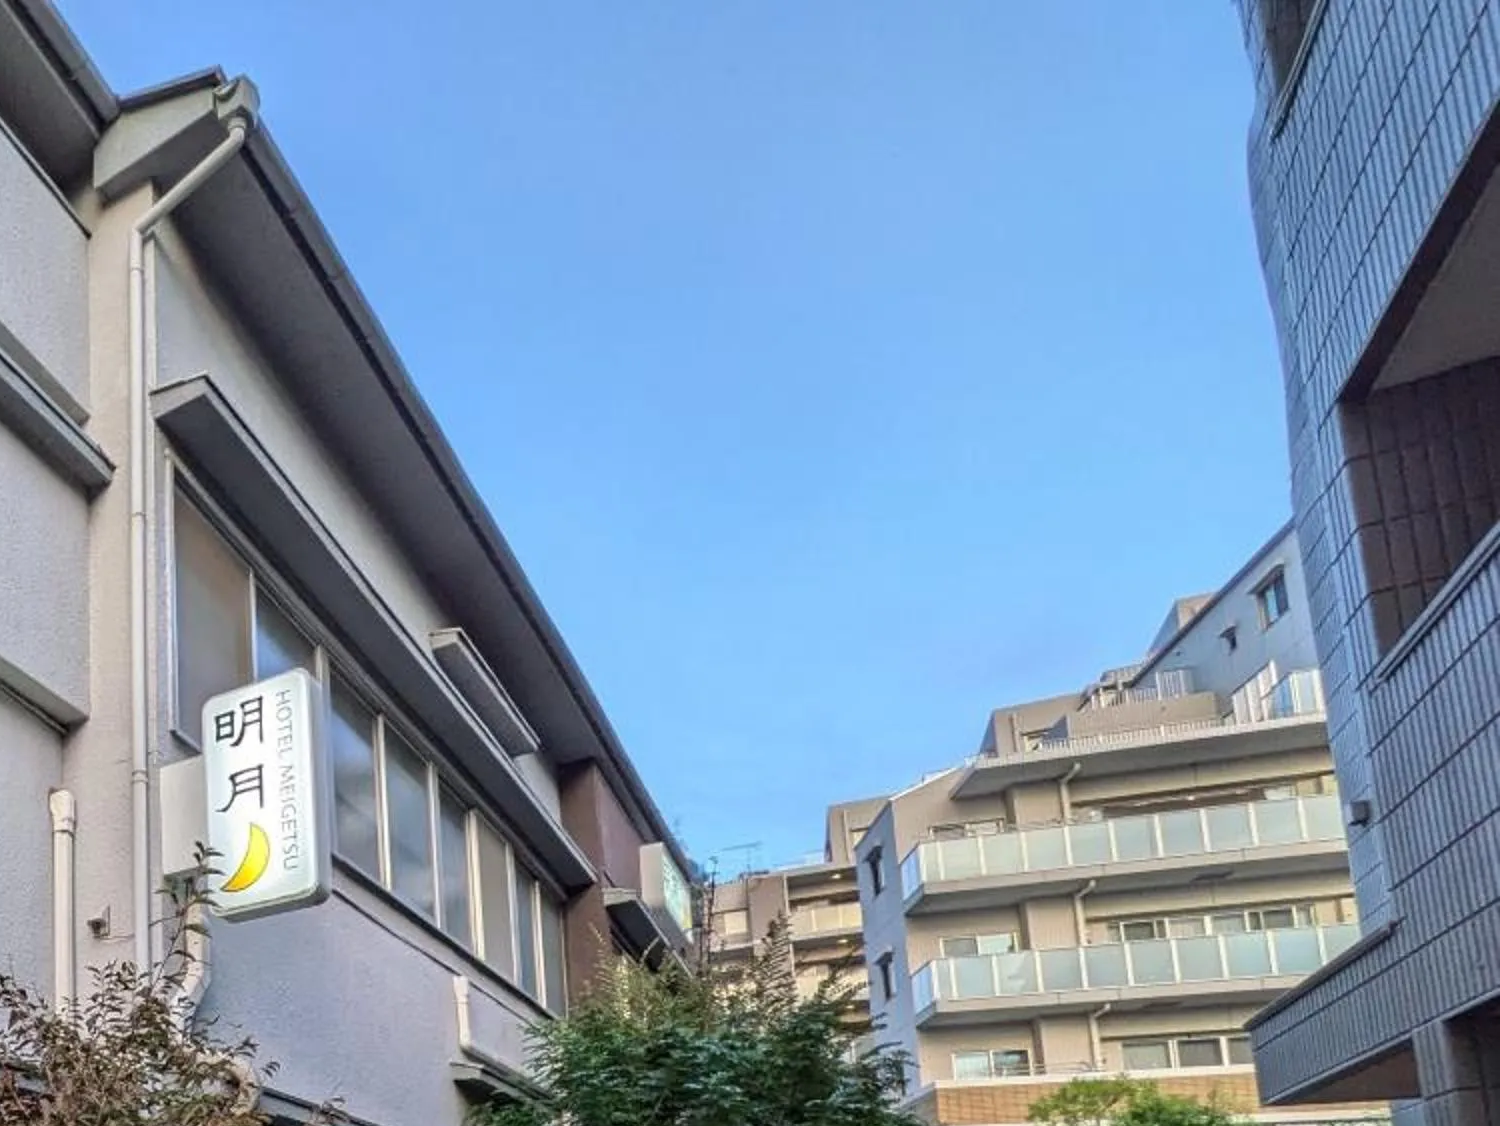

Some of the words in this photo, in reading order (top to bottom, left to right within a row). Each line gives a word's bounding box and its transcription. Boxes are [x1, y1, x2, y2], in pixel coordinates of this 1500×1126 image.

[214, 695, 264, 813] 明月
[276, 689, 294, 760] HOTEL
[279, 764, 301, 871] MEIGETSU
